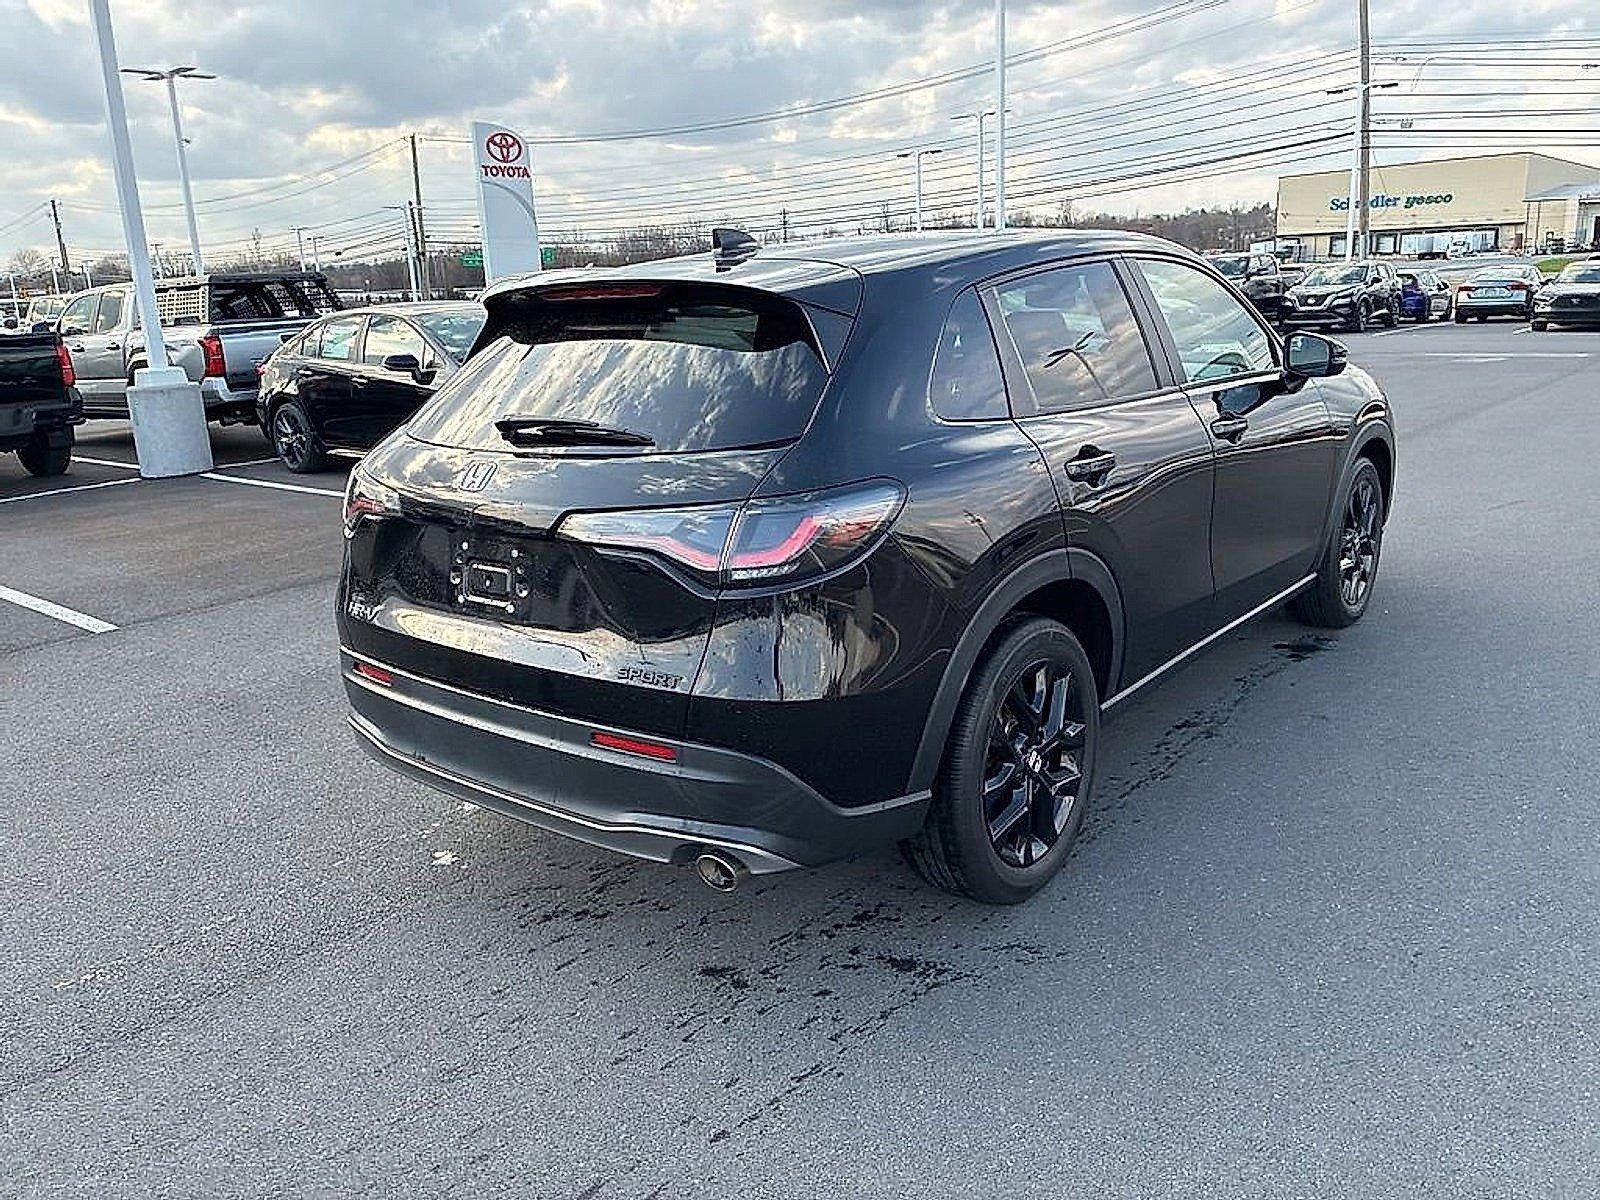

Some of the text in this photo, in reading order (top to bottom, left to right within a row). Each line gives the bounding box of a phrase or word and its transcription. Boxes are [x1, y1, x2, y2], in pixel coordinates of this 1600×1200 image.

[481, 164, 531, 178] TOYOTA
[1329, 194, 1400, 211] Scdler
[617, 667, 684, 689] SPORT
